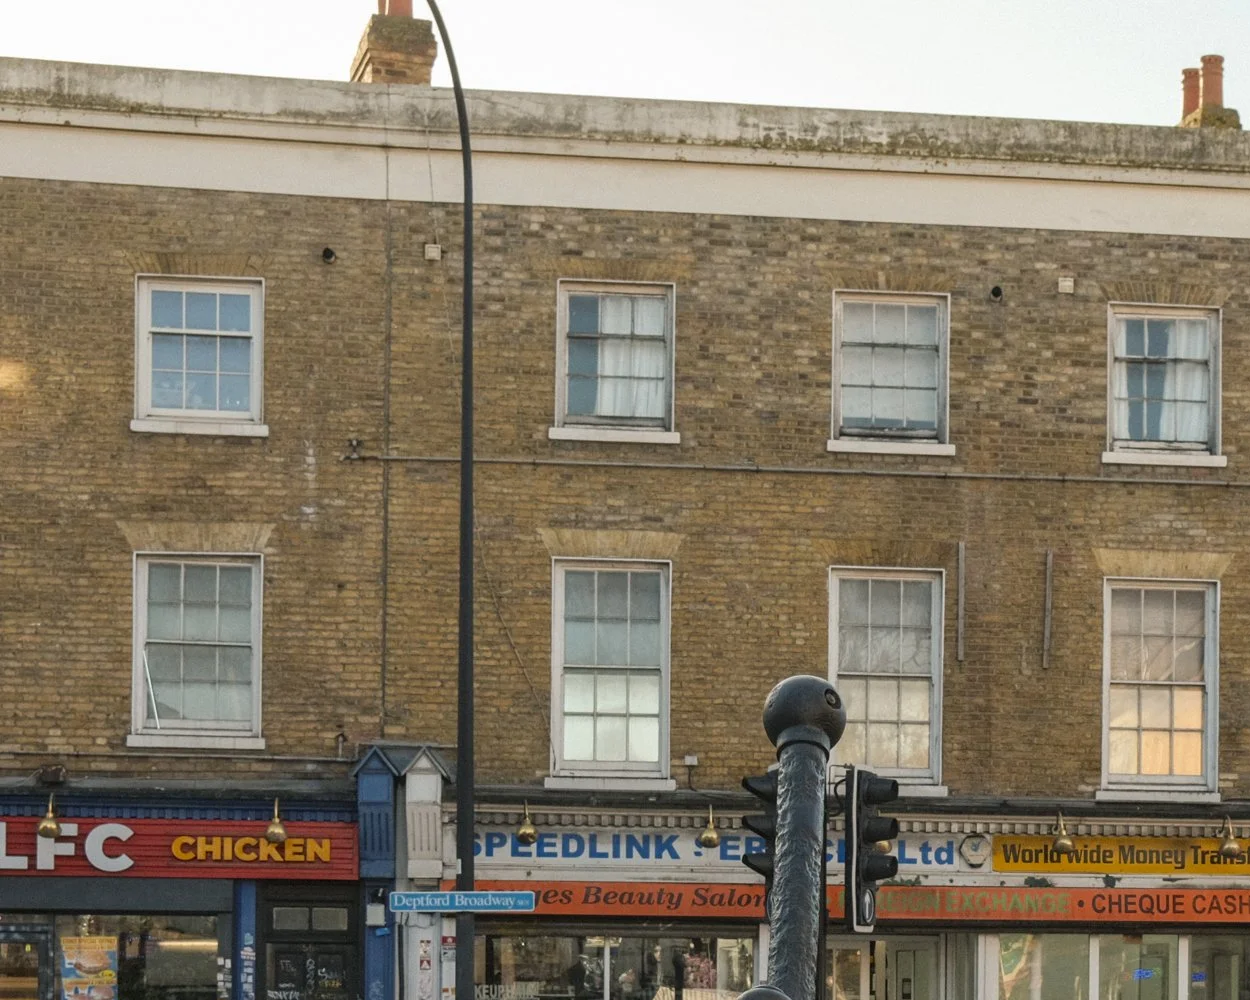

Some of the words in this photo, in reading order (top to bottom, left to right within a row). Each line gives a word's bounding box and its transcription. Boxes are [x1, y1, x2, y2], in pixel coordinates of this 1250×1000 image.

[171, 836, 331, 862] CHICKEN
[898, 839, 955, 866] Ltd
[1118, 844, 1186, 870] Money
[394, 894, 450, 910] Deptford
[455, 894, 516, 910] Broadway
[581, 886, 684, 911] Beauty
[691, 887, 768, 909] Salon
[946, 892, 1071, 913] EXCHANGE
[1092, 894, 1185, 915] CHEQUE
